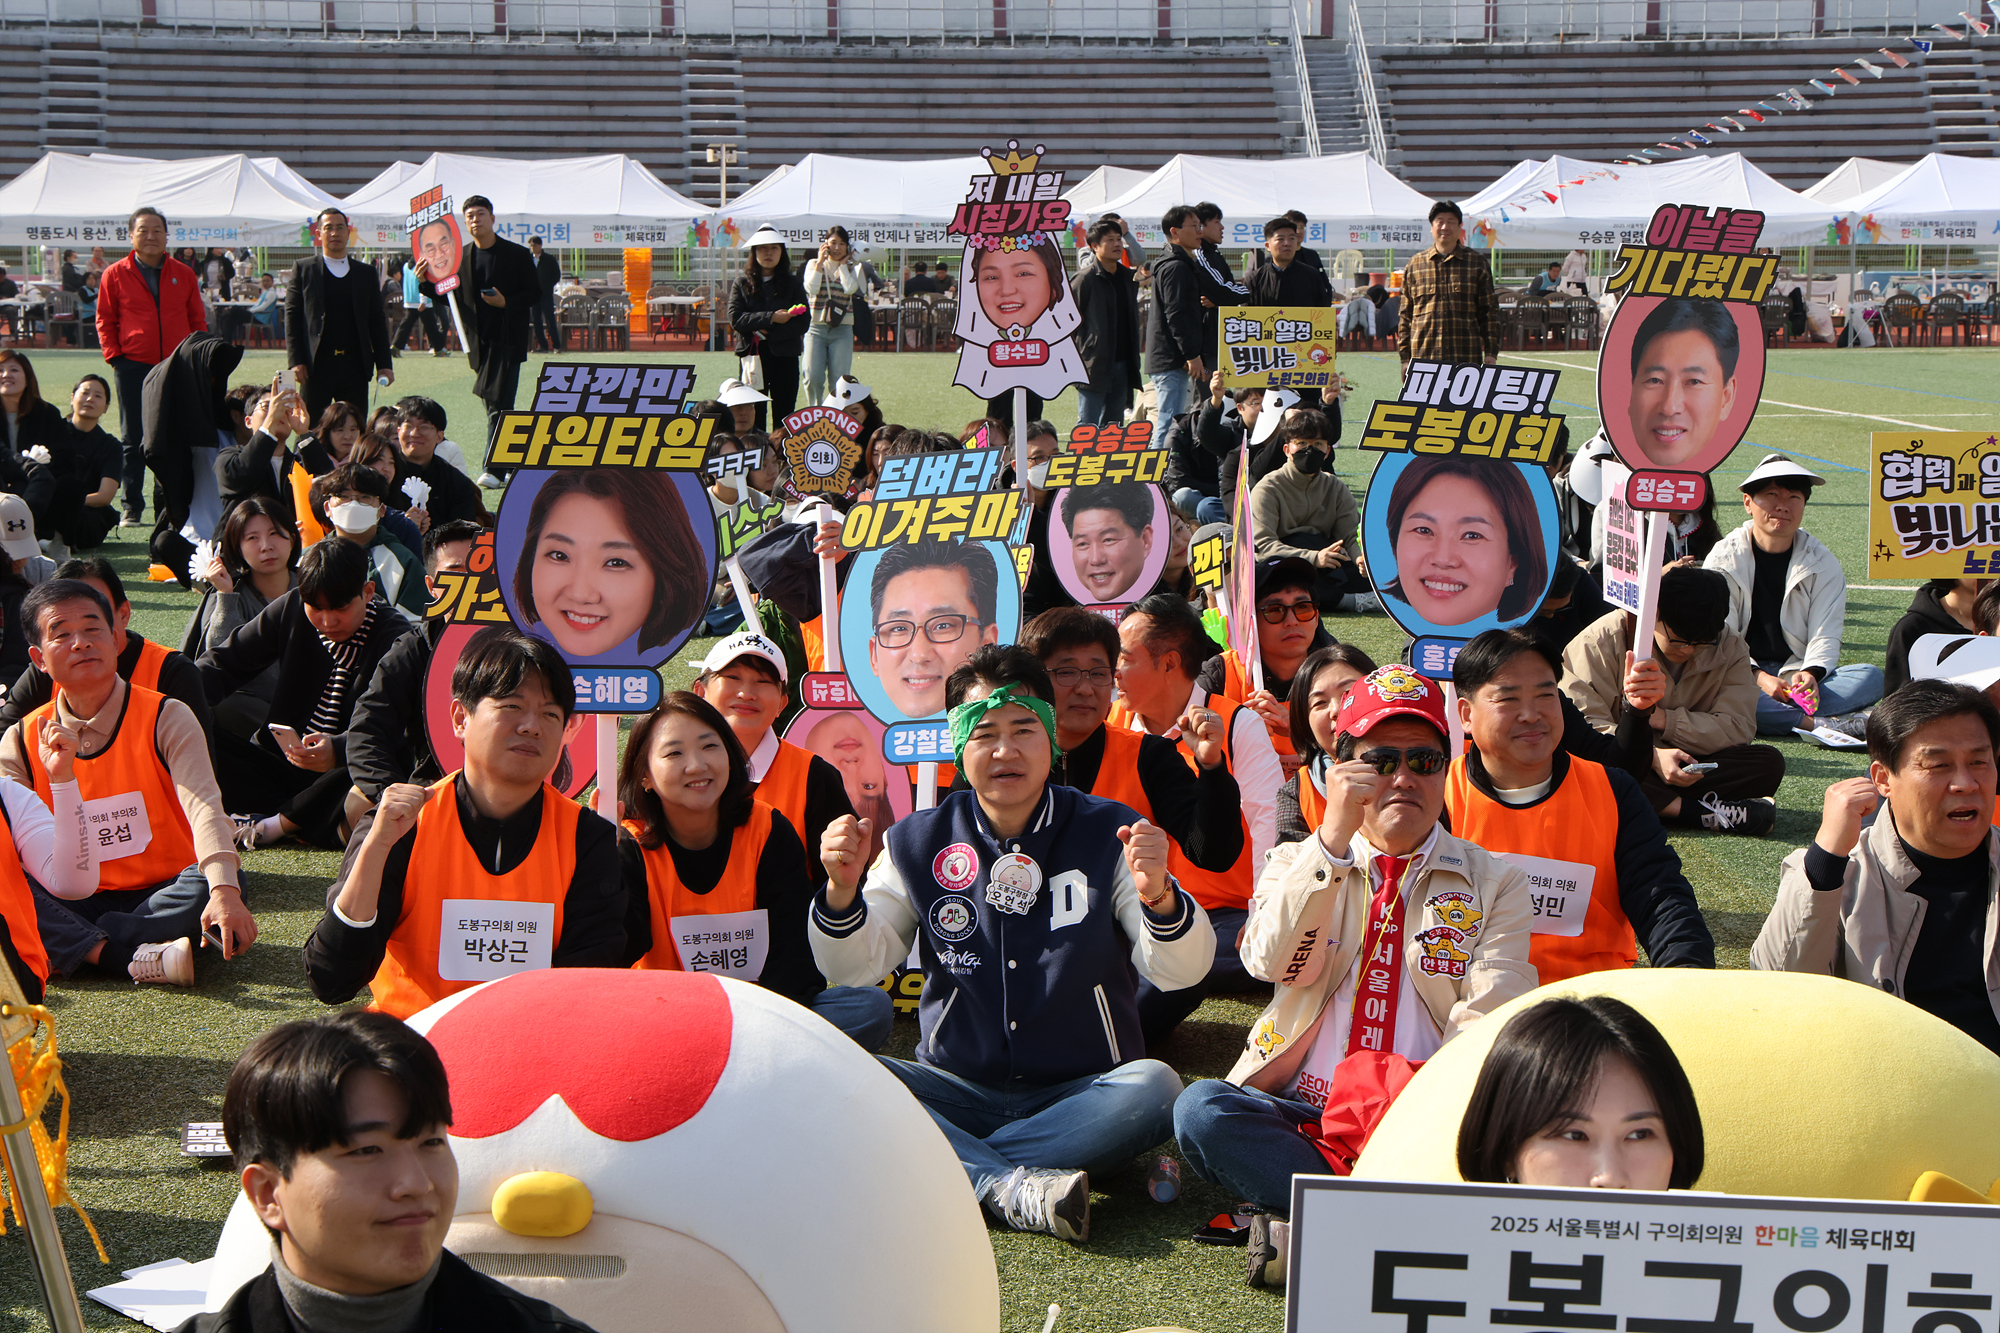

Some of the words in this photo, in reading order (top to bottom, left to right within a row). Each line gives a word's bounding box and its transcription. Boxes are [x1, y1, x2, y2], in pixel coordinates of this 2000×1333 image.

[411, 185, 443, 213] 절대로
[968, 175, 997, 202] 저
[1004, 171, 1065, 202] 내일
[406, 196, 453, 233] 안봐준다
[948, 201, 1070, 234] 시집가요
[26, 227, 78, 241] 명품도시
[82, 227, 111, 241] 용산,
[115, 227, 130, 241] 함
[174, 227, 238, 242] 용산구의회
[594, 232, 624, 243] 한마음
[625, 232, 667, 243] 체육대회
[874, 229, 910, 243] 언제나
[1350, 232, 1378, 243] 한마음
[1381, 232, 1422, 243] 체육대회
[1620, 230, 1645, 244] 열렸
[1648, 207, 1763, 254] 이날을
[1901, 228, 1931, 239] 한마음
[1934, 228, 1976, 239] 체육대회
[1608, 247, 1778, 302] 기다렸다
[995, 343, 1041, 361] 황수빈
[1230, 346, 1296, 375] 빛나는
[534, 366, 692, 414] 잠깐만
[1267, 372, 1330, 386] 노원구의회
[1401, 362, 1555, 414] 파이팅!
[788, 409, 859, 436] DOBONG
[1362, 403, 1562, 462] 도봉의회
[490, 414, 716, 468] 타임타임
[1067, 422, 1152, 454] 우승은
[810, 451, 835, 465] 의회
[1044, 449, 1170, 487] 도봉구다
[875, 450, 1000, 501] 덤벼라
[1635, 478, 1696, 504] 정승구
[841, 491, 1020, 549] 이겨주마
[1893, 504, 2000, 556] 빛나
[728, 639, 775, 656] HAZZYS
[572, 675, 648, 704] 손혜영
[111, 806, 138, 820] 부의장
[75, 803, 90, 871] Aimsak
[1438, 892, 1472, 903] DOBONG
[1555, 879, 1577, 892] 의원
[1049, 869, 1089, 931] D
[1379, 902, 1394, 920] K
[457, 919, 513, 934] 도봉구의회
[517, 920, 538, 934] 의원
[682, 931, 732, 946] 도봉구의회
[734, 929, 755, 942] 의원
[933, 922, 956, 939] DOBONG
[956, 925, 974, 938] SOCKS
[1373, 921, 1399, 934] POP
[1428, 927, 1462, 942] 도봉구의회
[464, 938, 529, 963] 박상근
[690, 946, 749, 973] 손혜영
[1299, 1071, 1334, 1096] SEOU
[1490, 1216, 1540, 1233] 2025
[1545, 1218, 1641, 1241] 서울특별시
[1646, 1222, 1743, 1245] 구의회의원
[1755, 1224, 1820, 1249] 한마음
[1825, 1227, 1916, 1253] 체육대회
